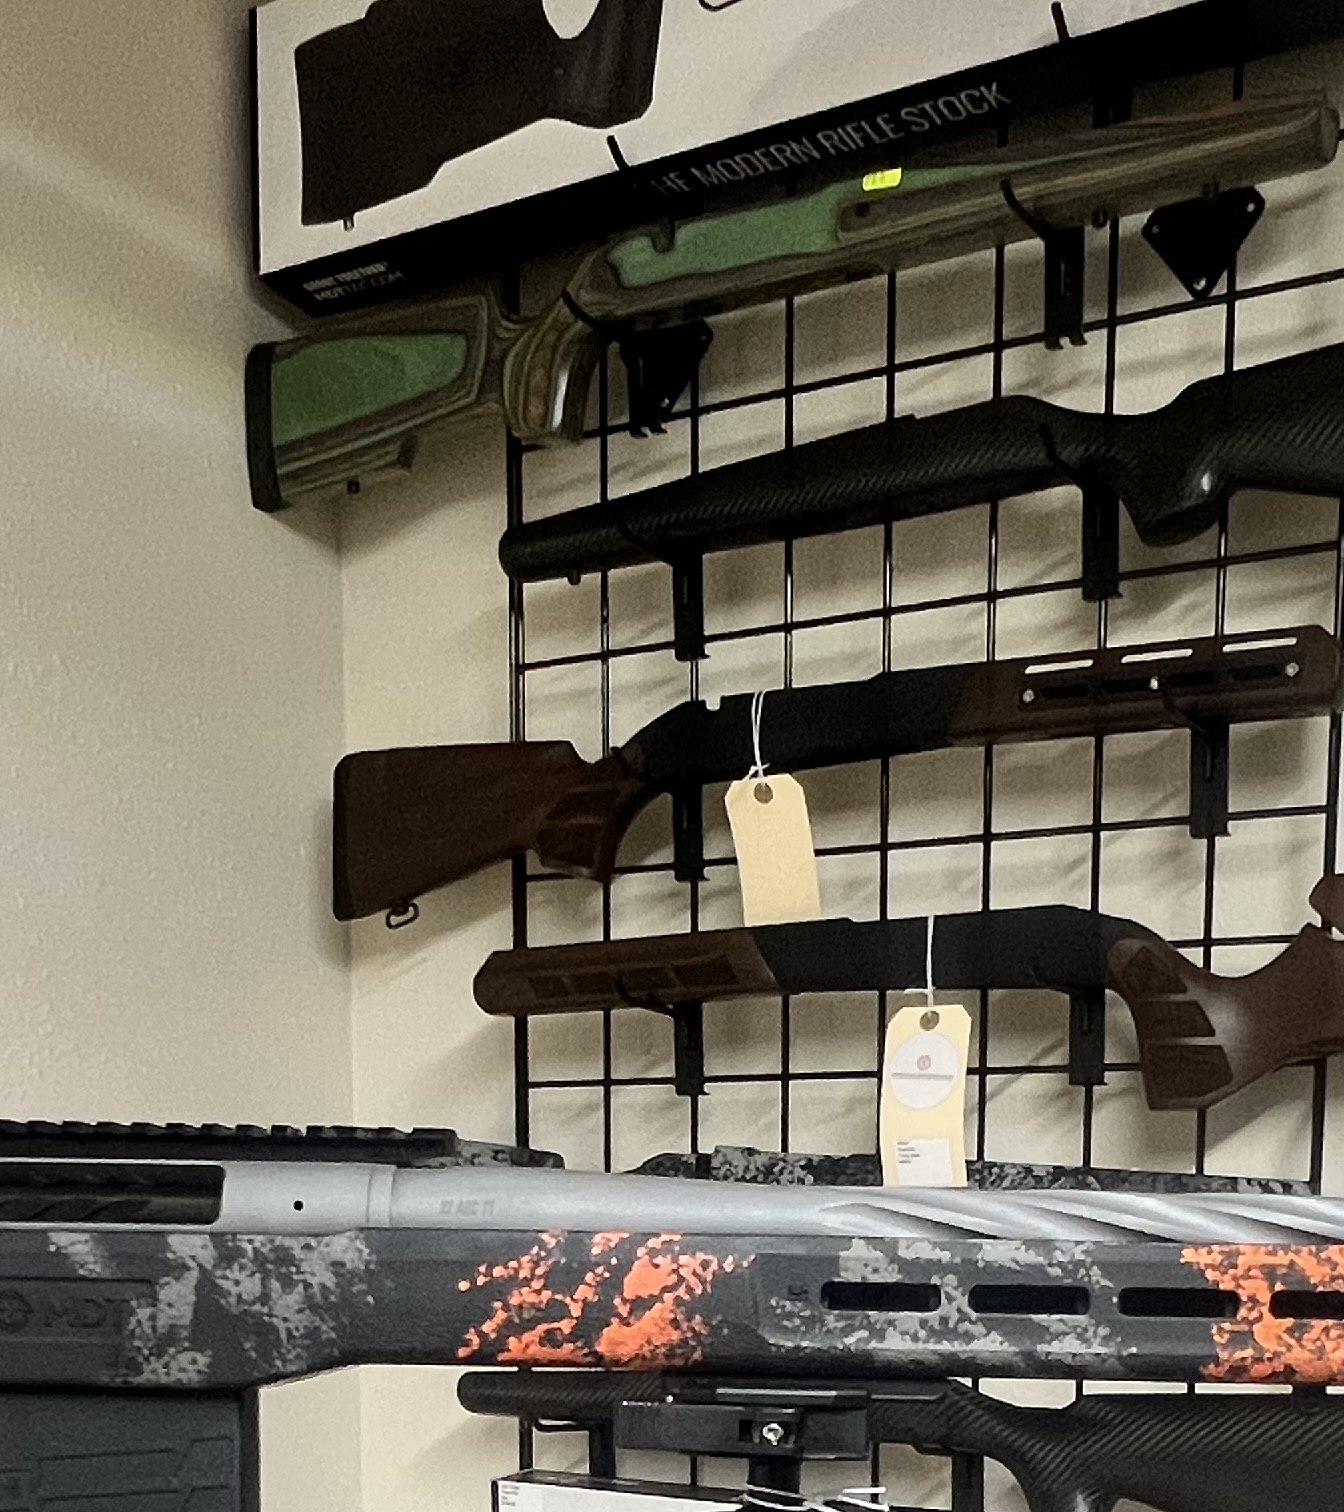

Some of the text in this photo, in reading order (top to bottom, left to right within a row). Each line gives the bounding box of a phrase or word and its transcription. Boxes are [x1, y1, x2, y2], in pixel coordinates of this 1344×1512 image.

[650, 81, 1011, 196] HE MODERN RIFLE STOCK
